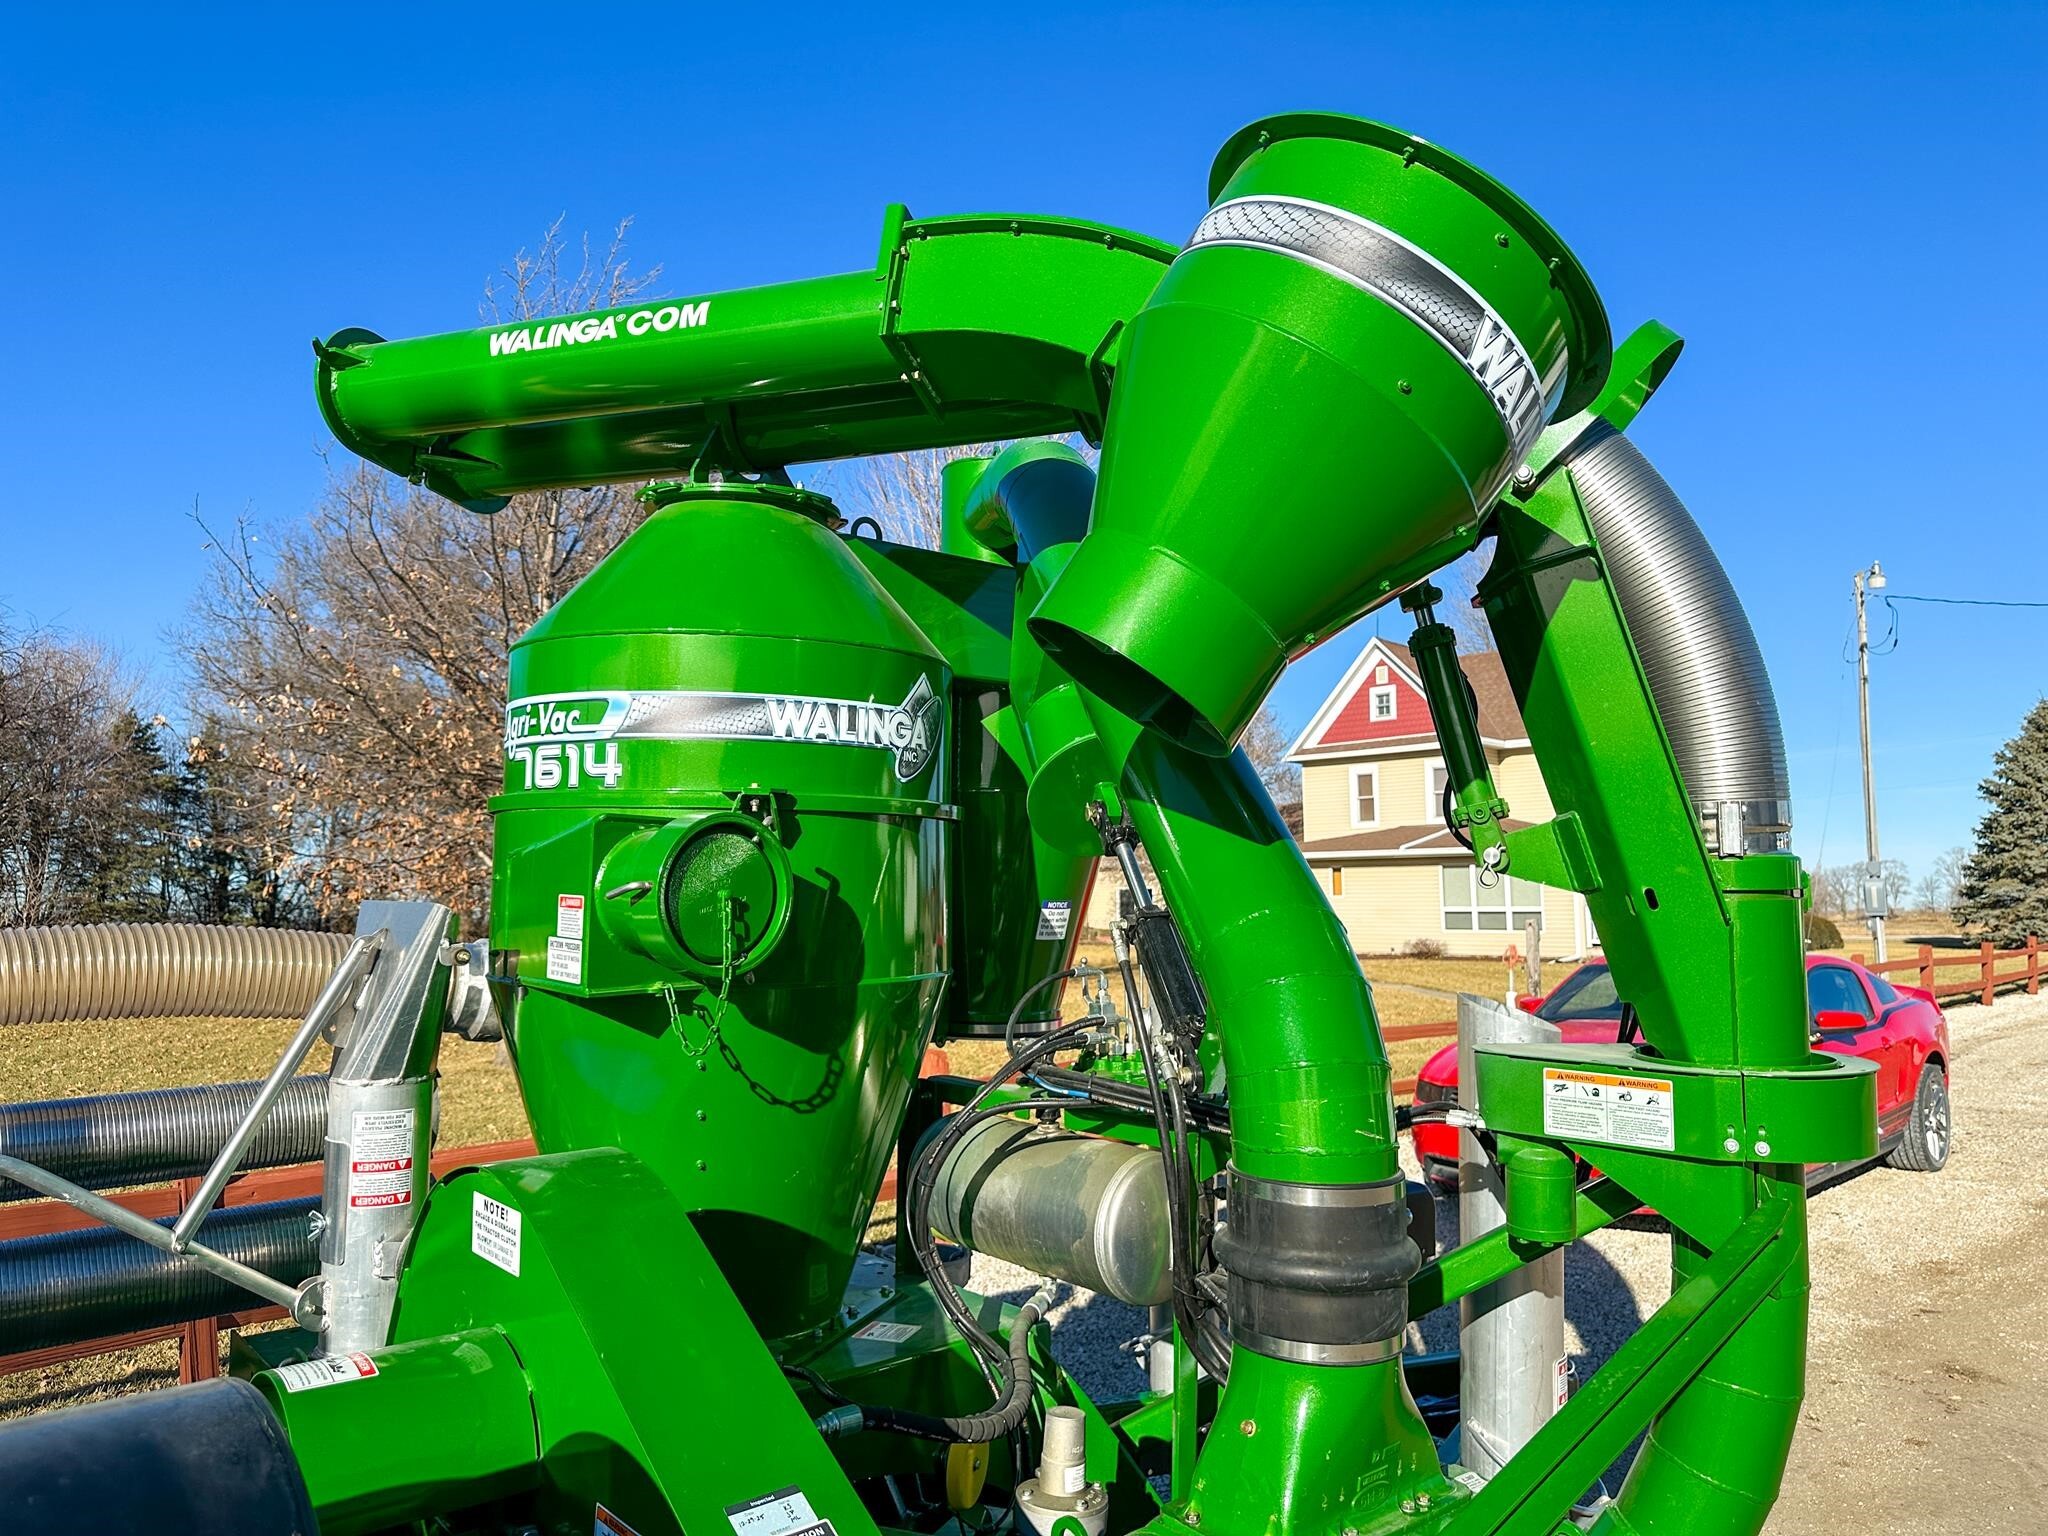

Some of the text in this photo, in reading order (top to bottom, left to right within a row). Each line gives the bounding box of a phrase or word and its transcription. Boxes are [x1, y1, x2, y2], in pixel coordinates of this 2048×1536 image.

[766, 699, 927, 751] WALINGA
[903, 751, 919, 763] INC.
[1047, 901, 1069, 909] NOTICE
[1564, 1073, 1595, 1083] WARNING
[1626, 1080, 1658, 1089] WARNING
[356, 1161, 396, 1172] DANGER
[355, 1195, 395, 1206] DANGER
[483, 1199, 508, 1222] NOTE!
[483, 1224, 500, 1239] TRACTOR
[500, 1234, 516, 1248] CLUTCH
[750, 1494, 775, 1507] Inspected
